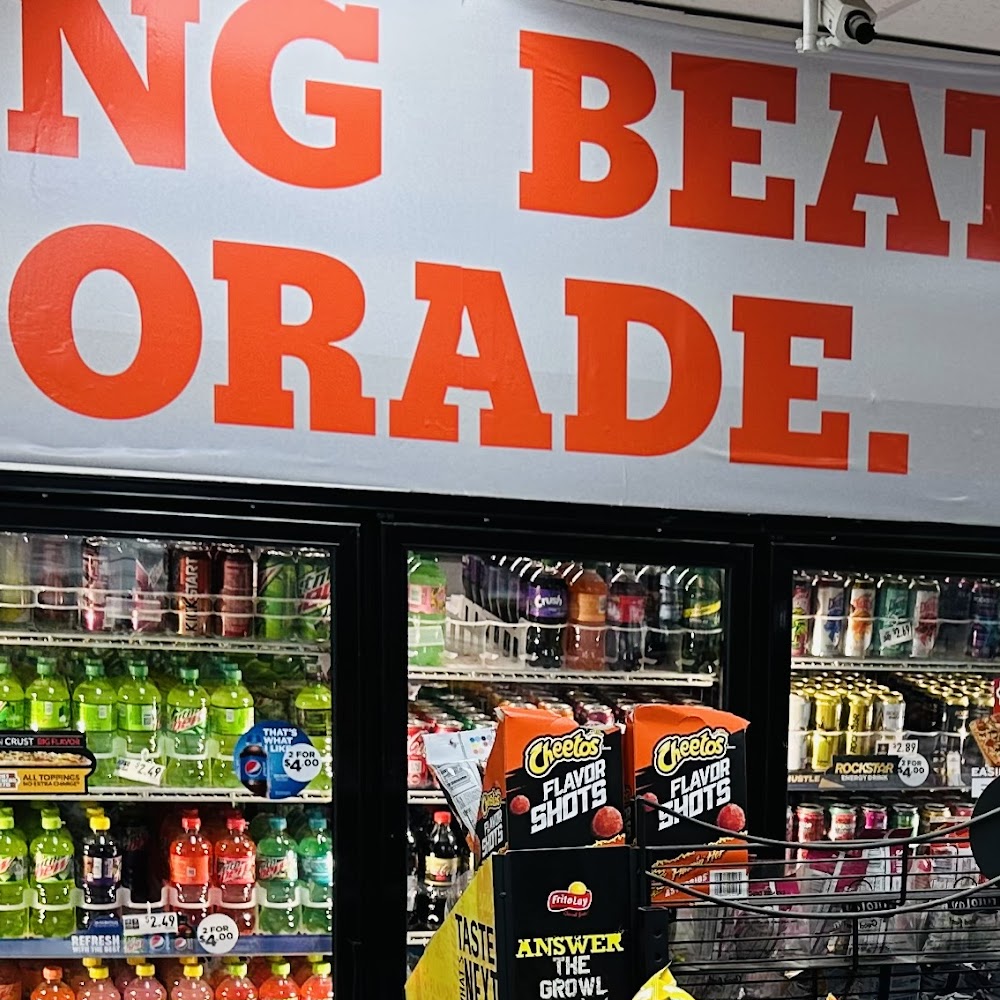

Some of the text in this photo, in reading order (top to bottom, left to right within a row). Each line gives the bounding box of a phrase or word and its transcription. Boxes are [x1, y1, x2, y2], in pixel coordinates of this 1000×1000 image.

[7, 0, 382, 189] NG
[8, 224, 909, 475] ORADE.
[534, 585, 563, 609] Crush
[4, 737, 34, 747] CRUST
[262, 727, 298, 738] THAT'S
[263, 737, 294, 745] WHAT
[284, 758, 320, 772] $4.00
[526, 730, 603, 778] Cheetos
[655, 730, 728, 776] Cheetos
[670, 758, 731, 800] FLAVOR
[834, 762, 895, 774] ROCKSTAR
[542, 759, 606, 802] FLAVOR
[530, 779, 607, 834] SHOTS
[657, 778, 731, 831] SHOTS
[144, 914, 176, 929] $2.49
[202, 925, 230, 934] 2 FOR
[71, 934, 121, 948] REFRESH
[455, 913, 496, 965] TASTE
[515, 931, 625, 958] ANSWER
[552, 955, 591, 975] THE
[539, 976, 608, 1000] GROWL
